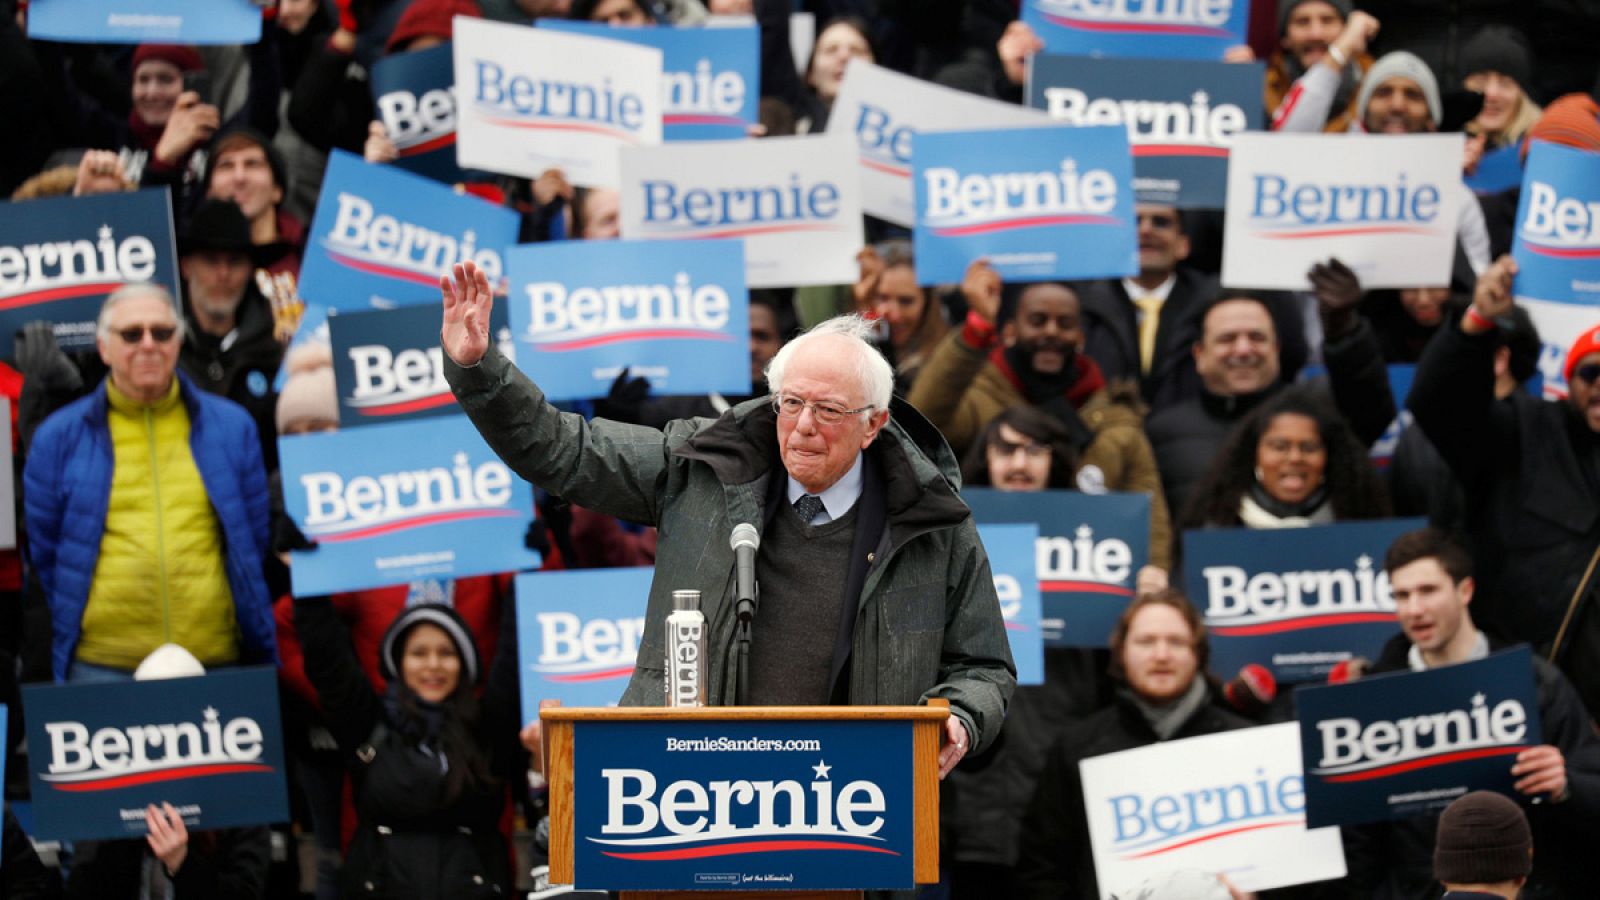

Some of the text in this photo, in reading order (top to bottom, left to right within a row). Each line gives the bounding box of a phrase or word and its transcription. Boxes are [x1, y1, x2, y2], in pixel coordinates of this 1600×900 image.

[475, 60, 643, 130] Bernie
[641, 172, 840, 225] Bernie
[925, 157, 1116, 216] Bernie
[1251, 173, 1440, 223] Bernie
[330, 193, 503, 285] Bernie
[526, 271, 730, 335] Bernie
[301, 453, 512, 526] Bernie
[45, 705, 263, 773] Bernie
[666, 737, 820, 752] BernieSanders.com
[1316, 692, 1527, 767] Bernie
[601, 759, 886, 836] Bernie
[1108, 768, 1306, 842] Bernie
